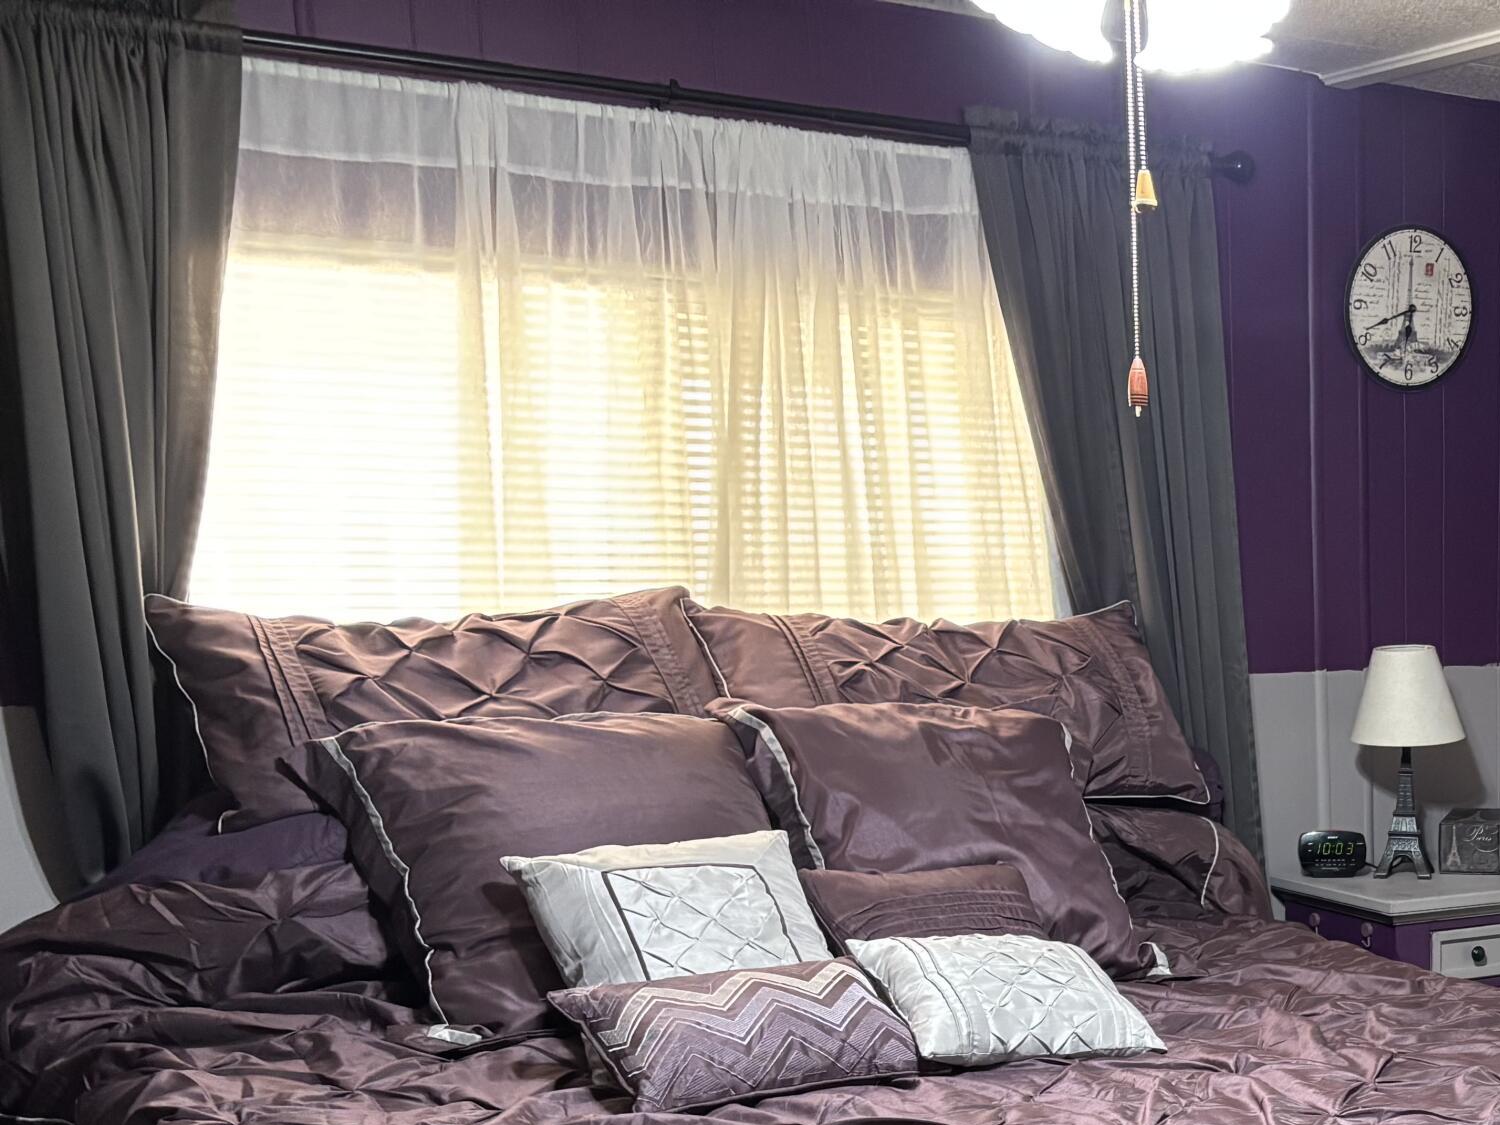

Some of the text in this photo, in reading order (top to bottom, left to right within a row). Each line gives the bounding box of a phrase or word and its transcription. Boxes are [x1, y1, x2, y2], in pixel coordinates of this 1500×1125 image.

[1409, 235, 1422, 253] 12
[1361, 262, 1378, 282] 10
[1448, 272, 1463, 289] 2
[1353, 298, 1369, 310] 9
[1453, 306, 1467, 318] 3
[1358, 332, 1372, 346] 8
[1404, 363, 1413, 380] 6
[1427, 356, 1439, 373] 5
[1464, 824, 1492, 841] Paris
[1317, 842, 1354, 855] 10:03
